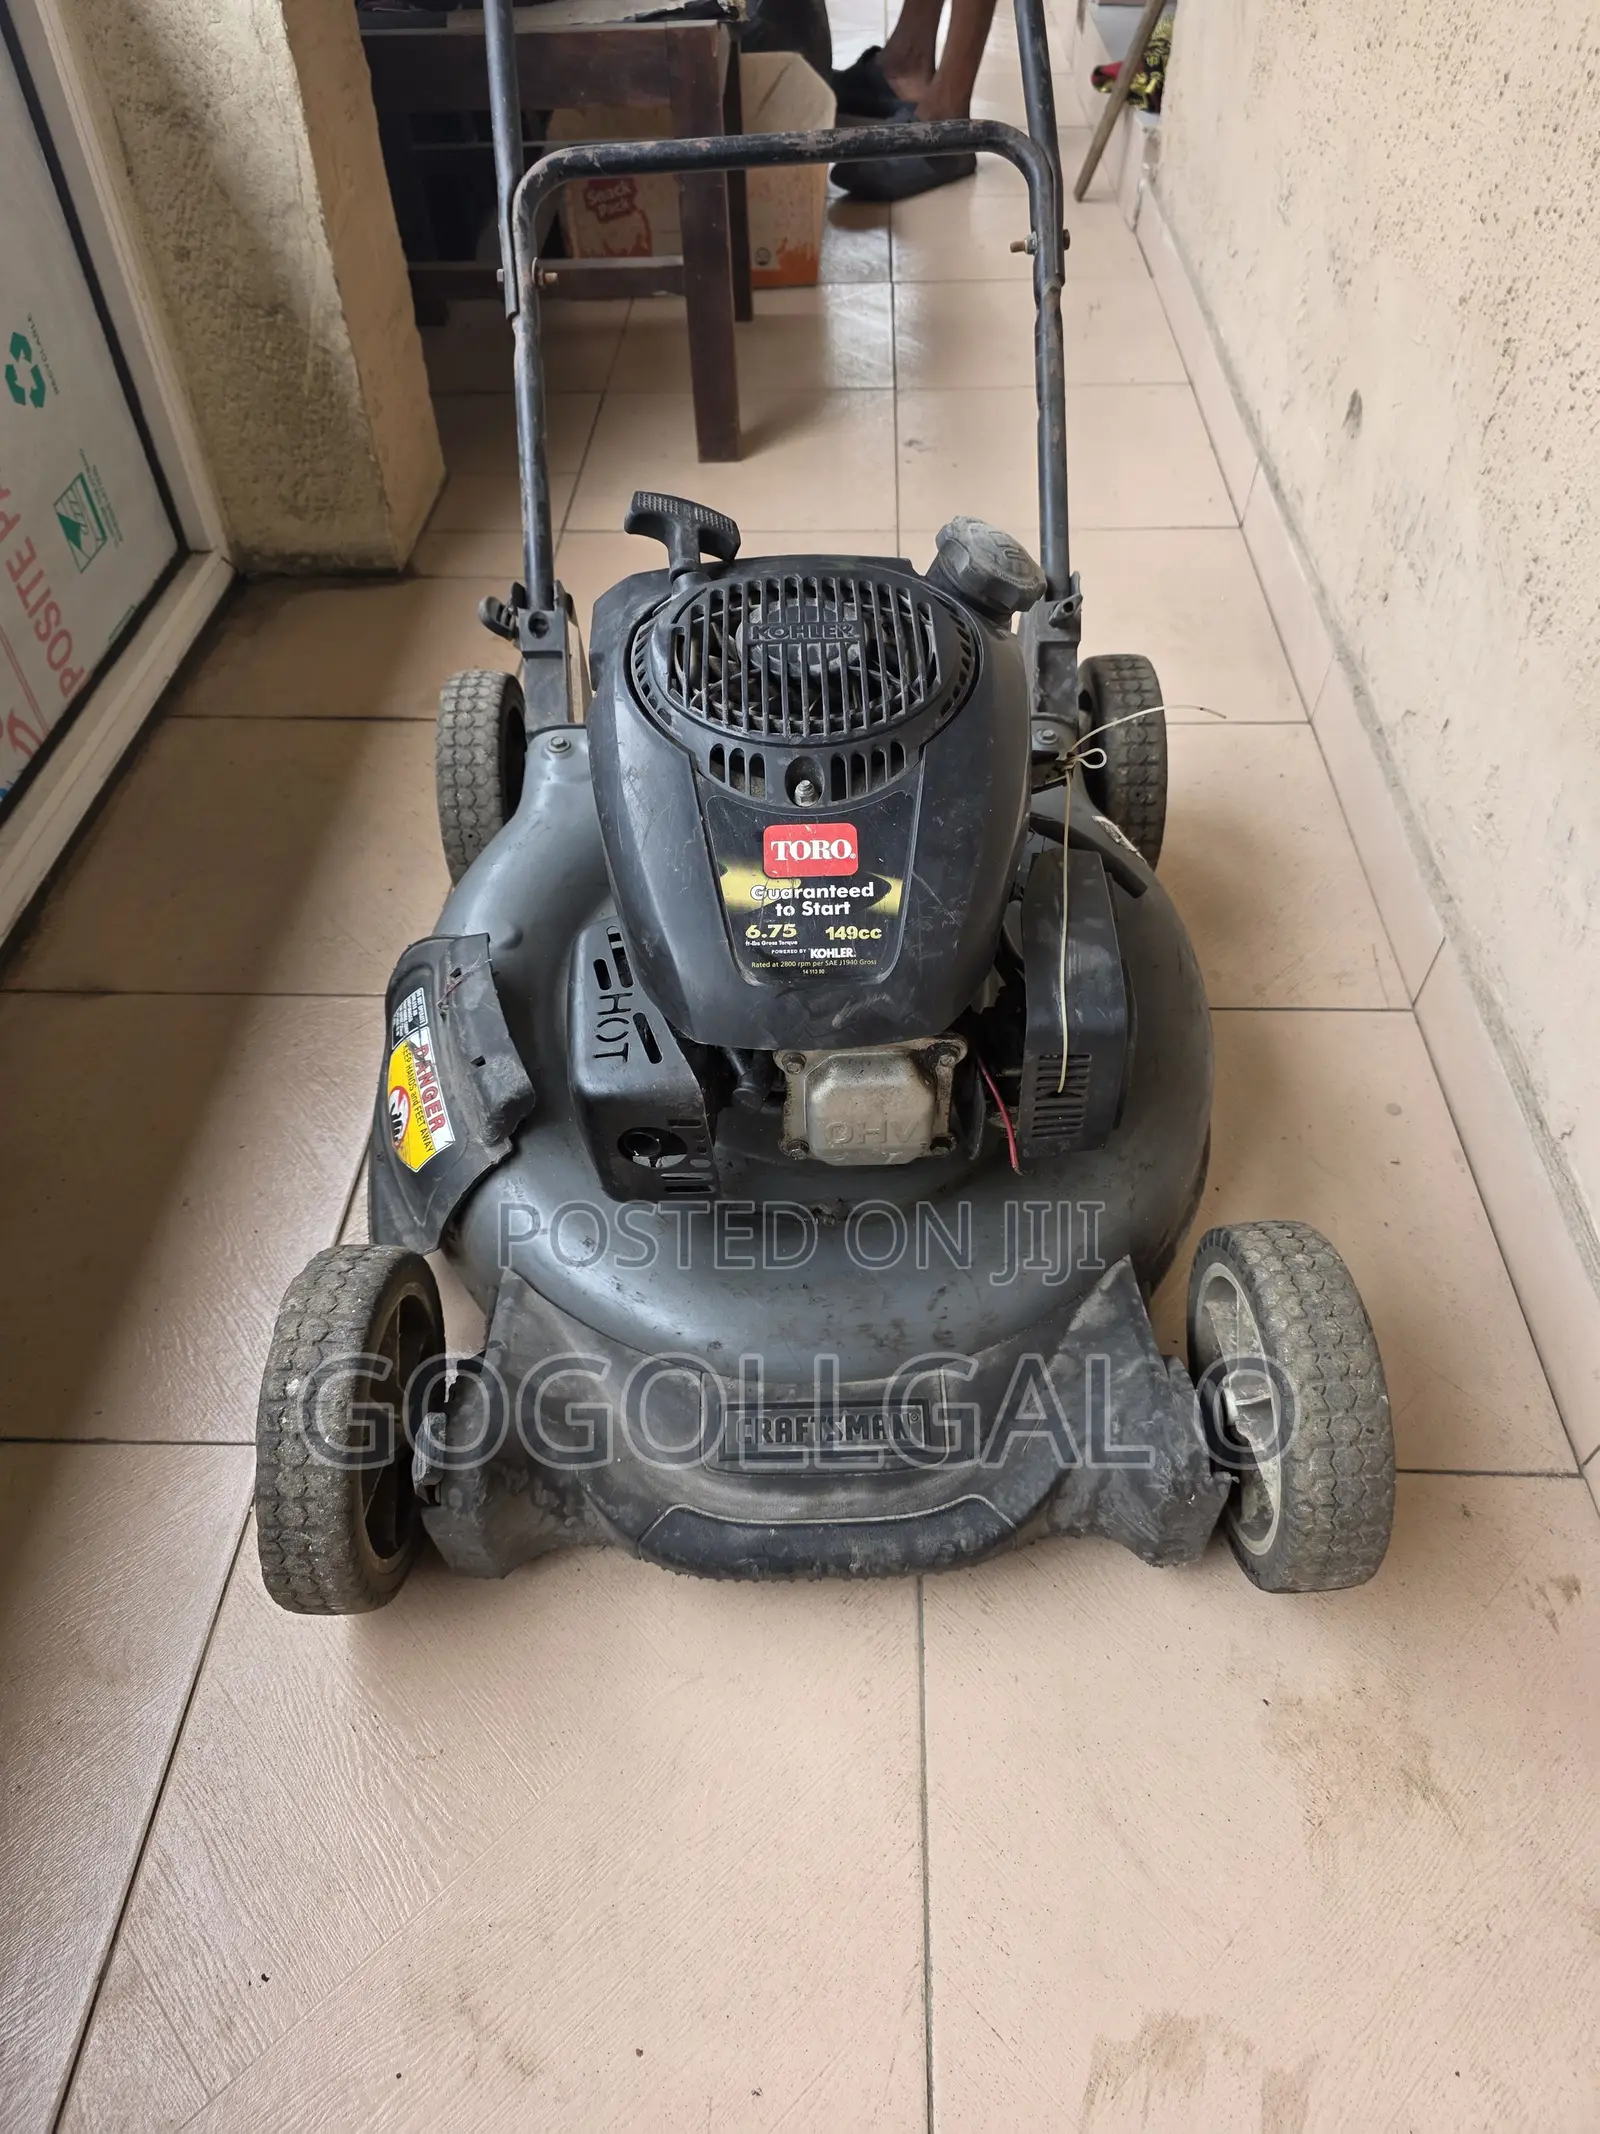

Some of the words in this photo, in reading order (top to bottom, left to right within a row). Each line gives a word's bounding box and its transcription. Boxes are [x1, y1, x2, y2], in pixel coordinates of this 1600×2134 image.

[587, 180, 632, 205] Snack
[597, 195, 629, 217] Pack
[751, 624, 854, 641] KOHLER
[750, 882, 875, 901] Guaranteed
[775, 904, 796, 917] to
[801, 901, 851, 917] Start
[745, 924, 798, 939] 6.75
[825, 926, 883, 941] 149cc
[797, 961, 812, 969] rpm
[839, 959, 858, 967] J1940
[593, 992, 633, 1063] HOT
[405, 1063, 417, 1092] HANDS
[415, 1044, 446, 1133] DANGER
[411, 1092, 419, 1106] and
[414, 1106, 425, 1127] FEET
[420, 1128, 433, 1152] AWAY
[825, 1121, 919, 1145] OHV
[736, 1414, 910, 1444] CRAFTSMAN
